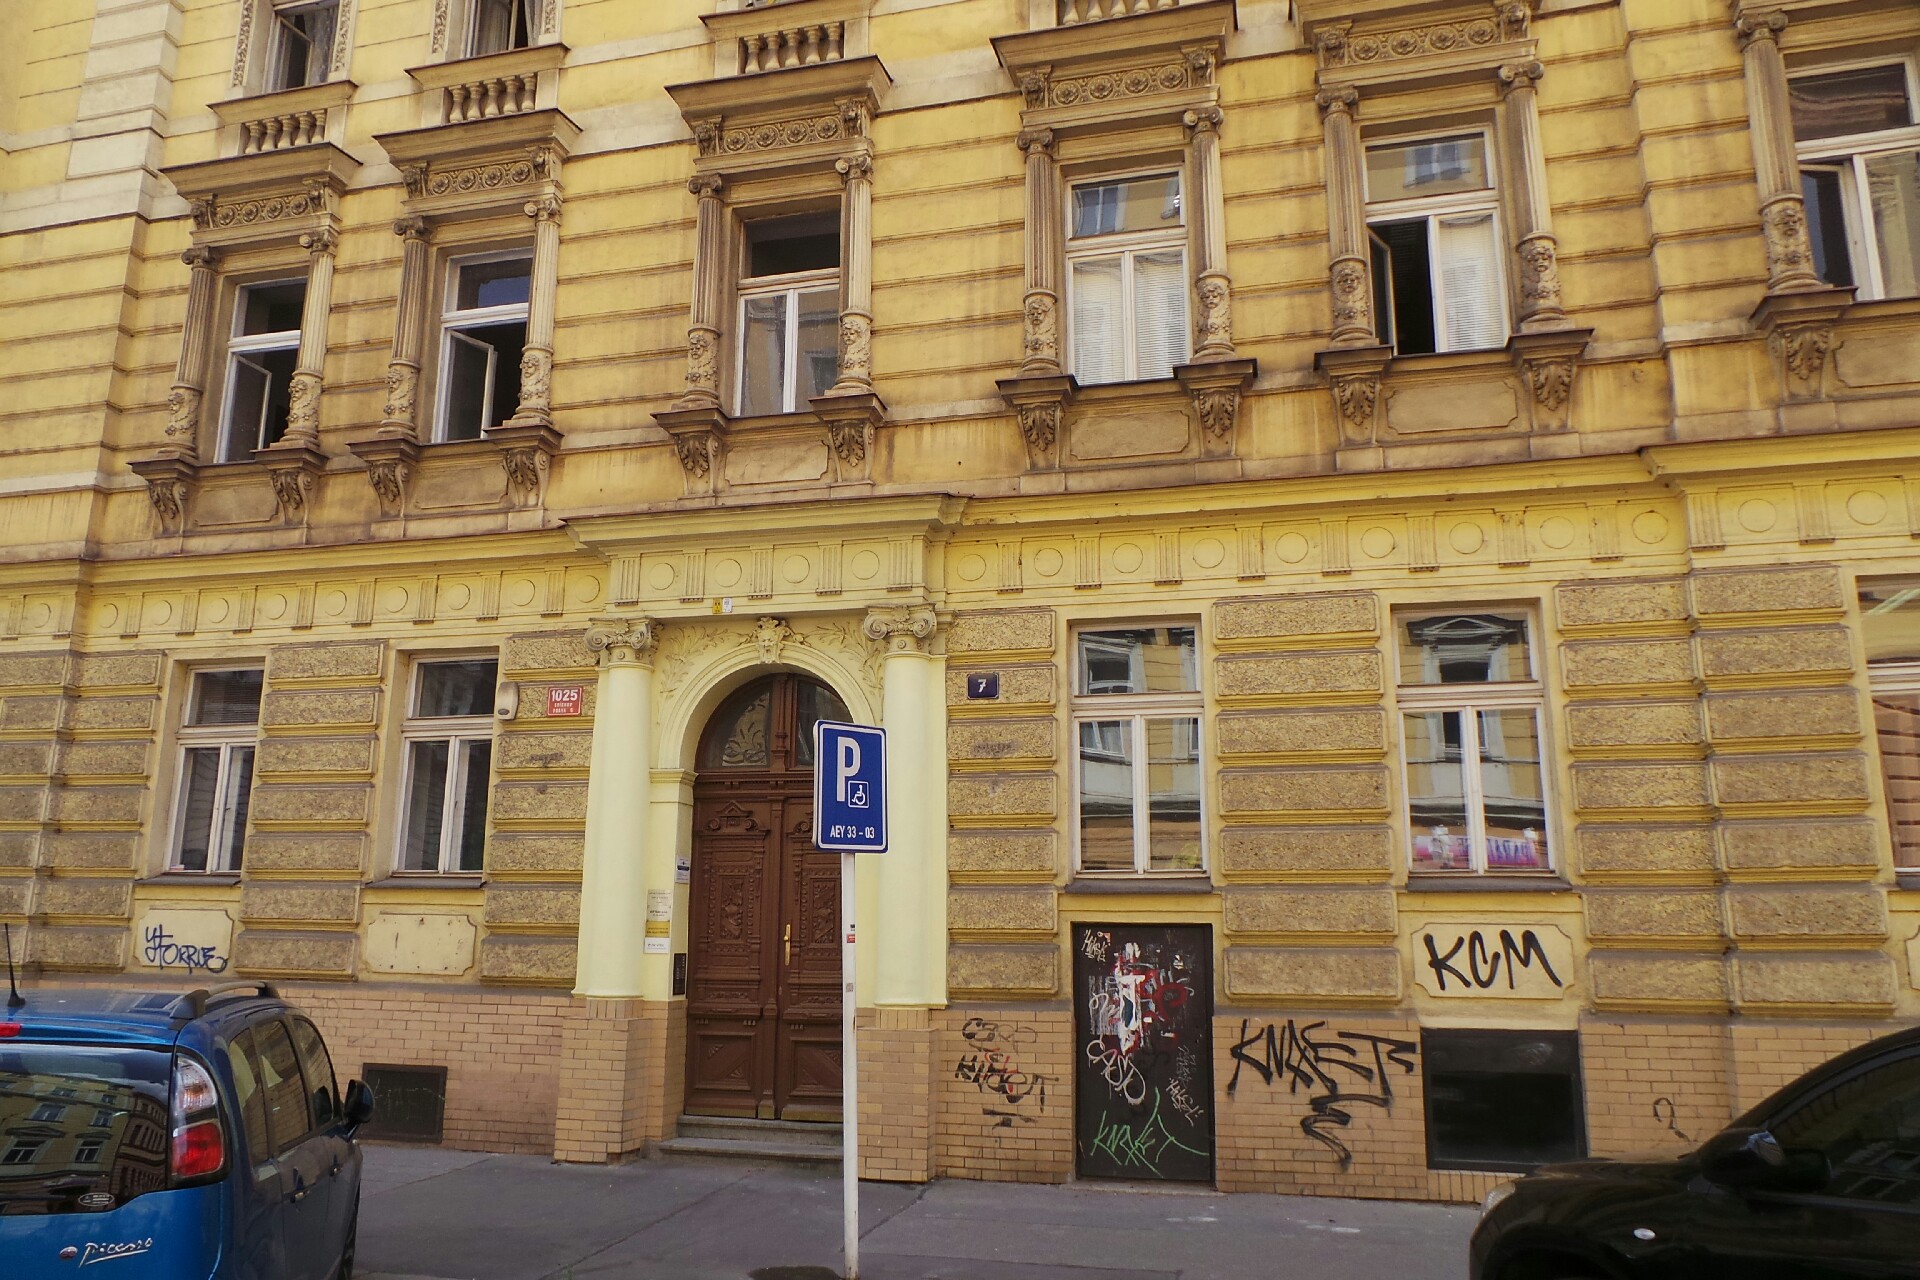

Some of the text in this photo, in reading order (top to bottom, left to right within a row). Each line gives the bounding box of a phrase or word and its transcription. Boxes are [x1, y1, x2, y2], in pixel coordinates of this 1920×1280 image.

[977, 678, 987, 693] 7
[551, 689, 579, 702] 1025
[836, 736, 861, 802] P
[830, 825, 846, 838] AEY
[846, 825, 857, 838] 33
[864, 826, 875, 839] 03
